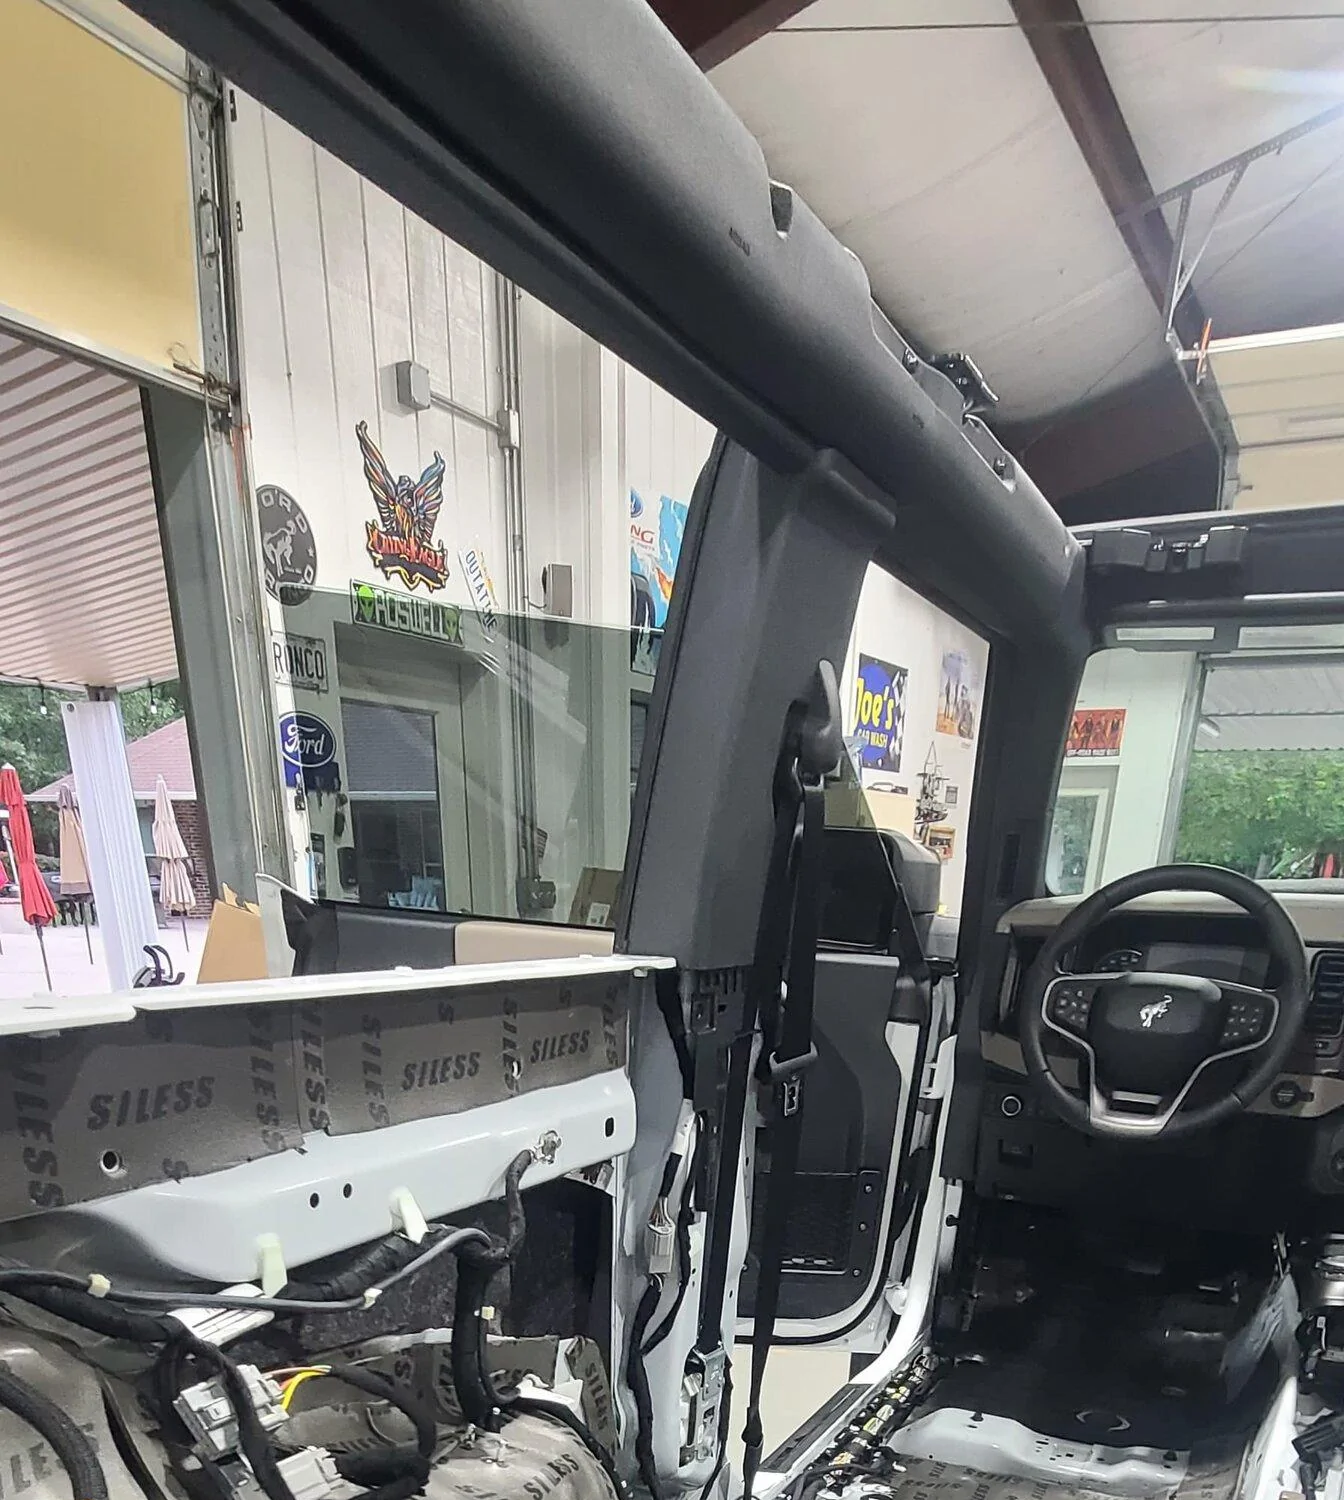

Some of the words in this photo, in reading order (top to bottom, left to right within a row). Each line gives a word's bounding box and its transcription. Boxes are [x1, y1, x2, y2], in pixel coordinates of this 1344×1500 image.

[260, 490, 308, 534] ORD
[375, 589, 450, 640] ROSWELL
[273, 642, 325, 680] RONCO
[851, 677, 895, 735] Joe's
[284, 723, 325, 755] Ford
[530, 1029, 591, 1064] SILESS
[402, 1052, 481, 1091] SILESS
[86, 1076, 215, 1131] SILESS
